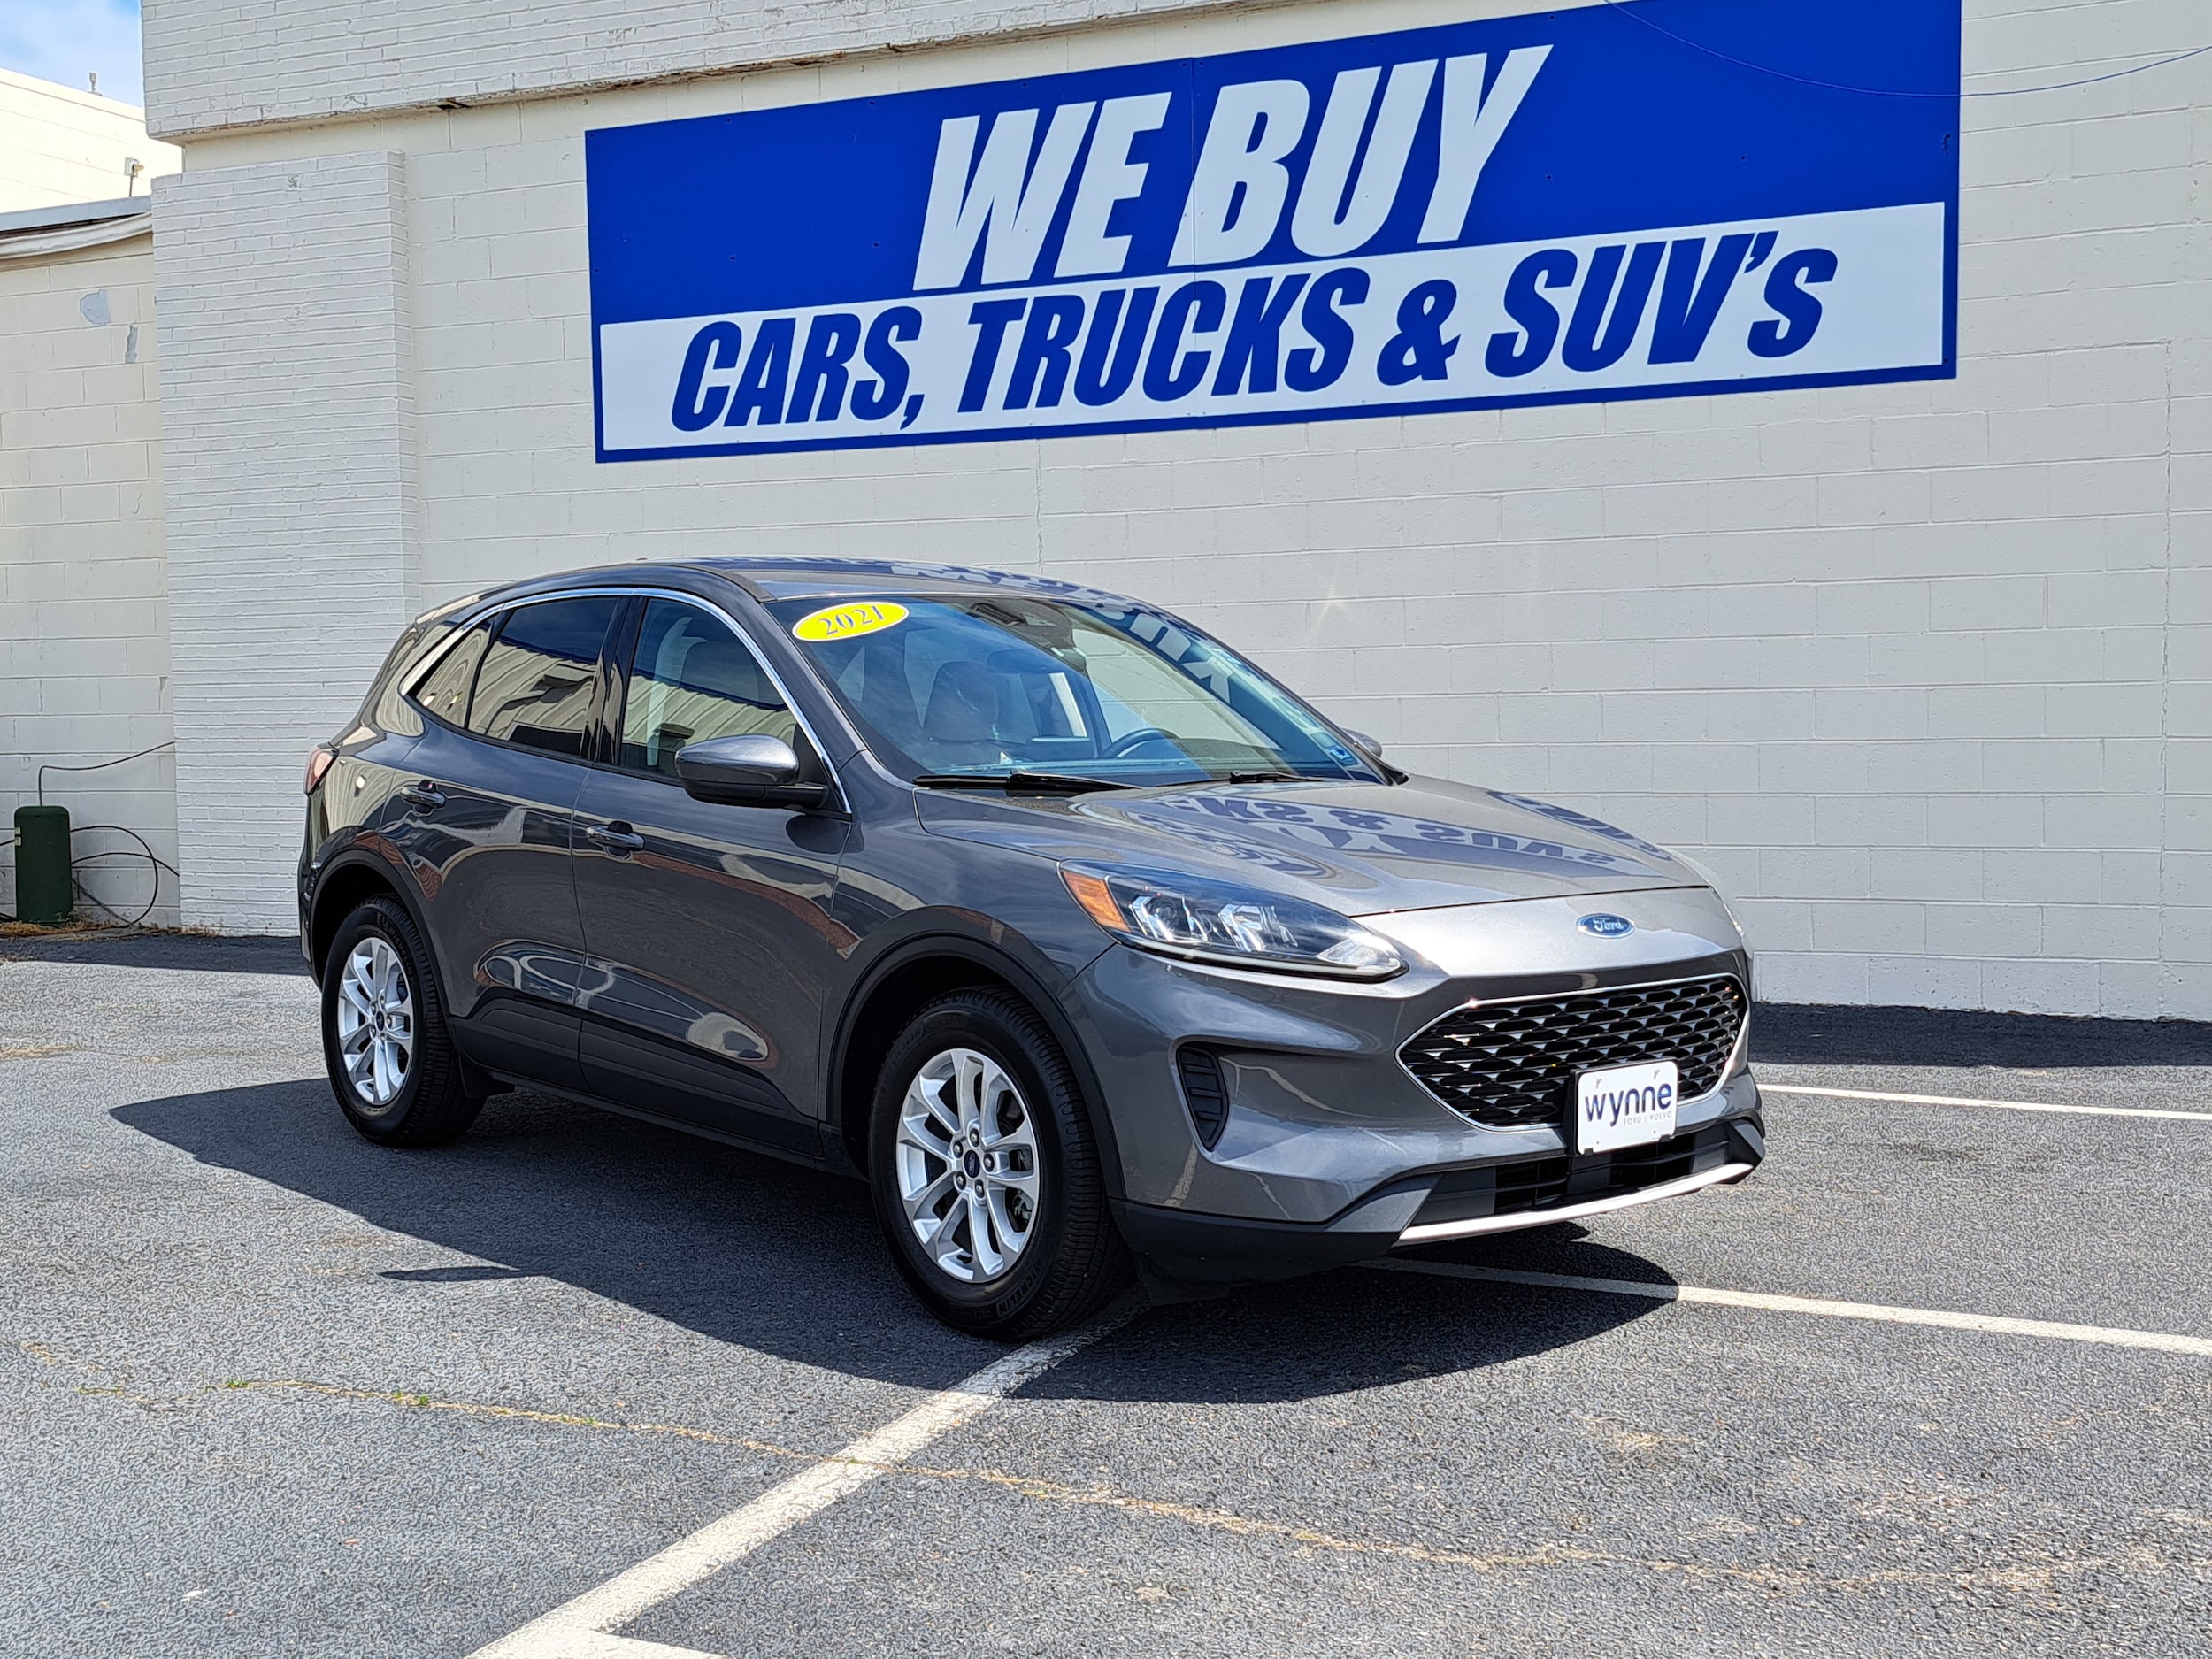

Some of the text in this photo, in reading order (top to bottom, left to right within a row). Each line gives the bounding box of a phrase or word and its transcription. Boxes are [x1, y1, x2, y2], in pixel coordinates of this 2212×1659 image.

[912, 44, 1554, 290] WE BUY
[671, 306, 926, 432] CARS,
[956, 267, 1371, 413] TRUCKS
[1376, 279, 1462, 386] &
[817, 605, 885, 636] 2021
[1592, 917, 1625, 932] Ford
[1585, 1082, 1672, 1127] wynne
